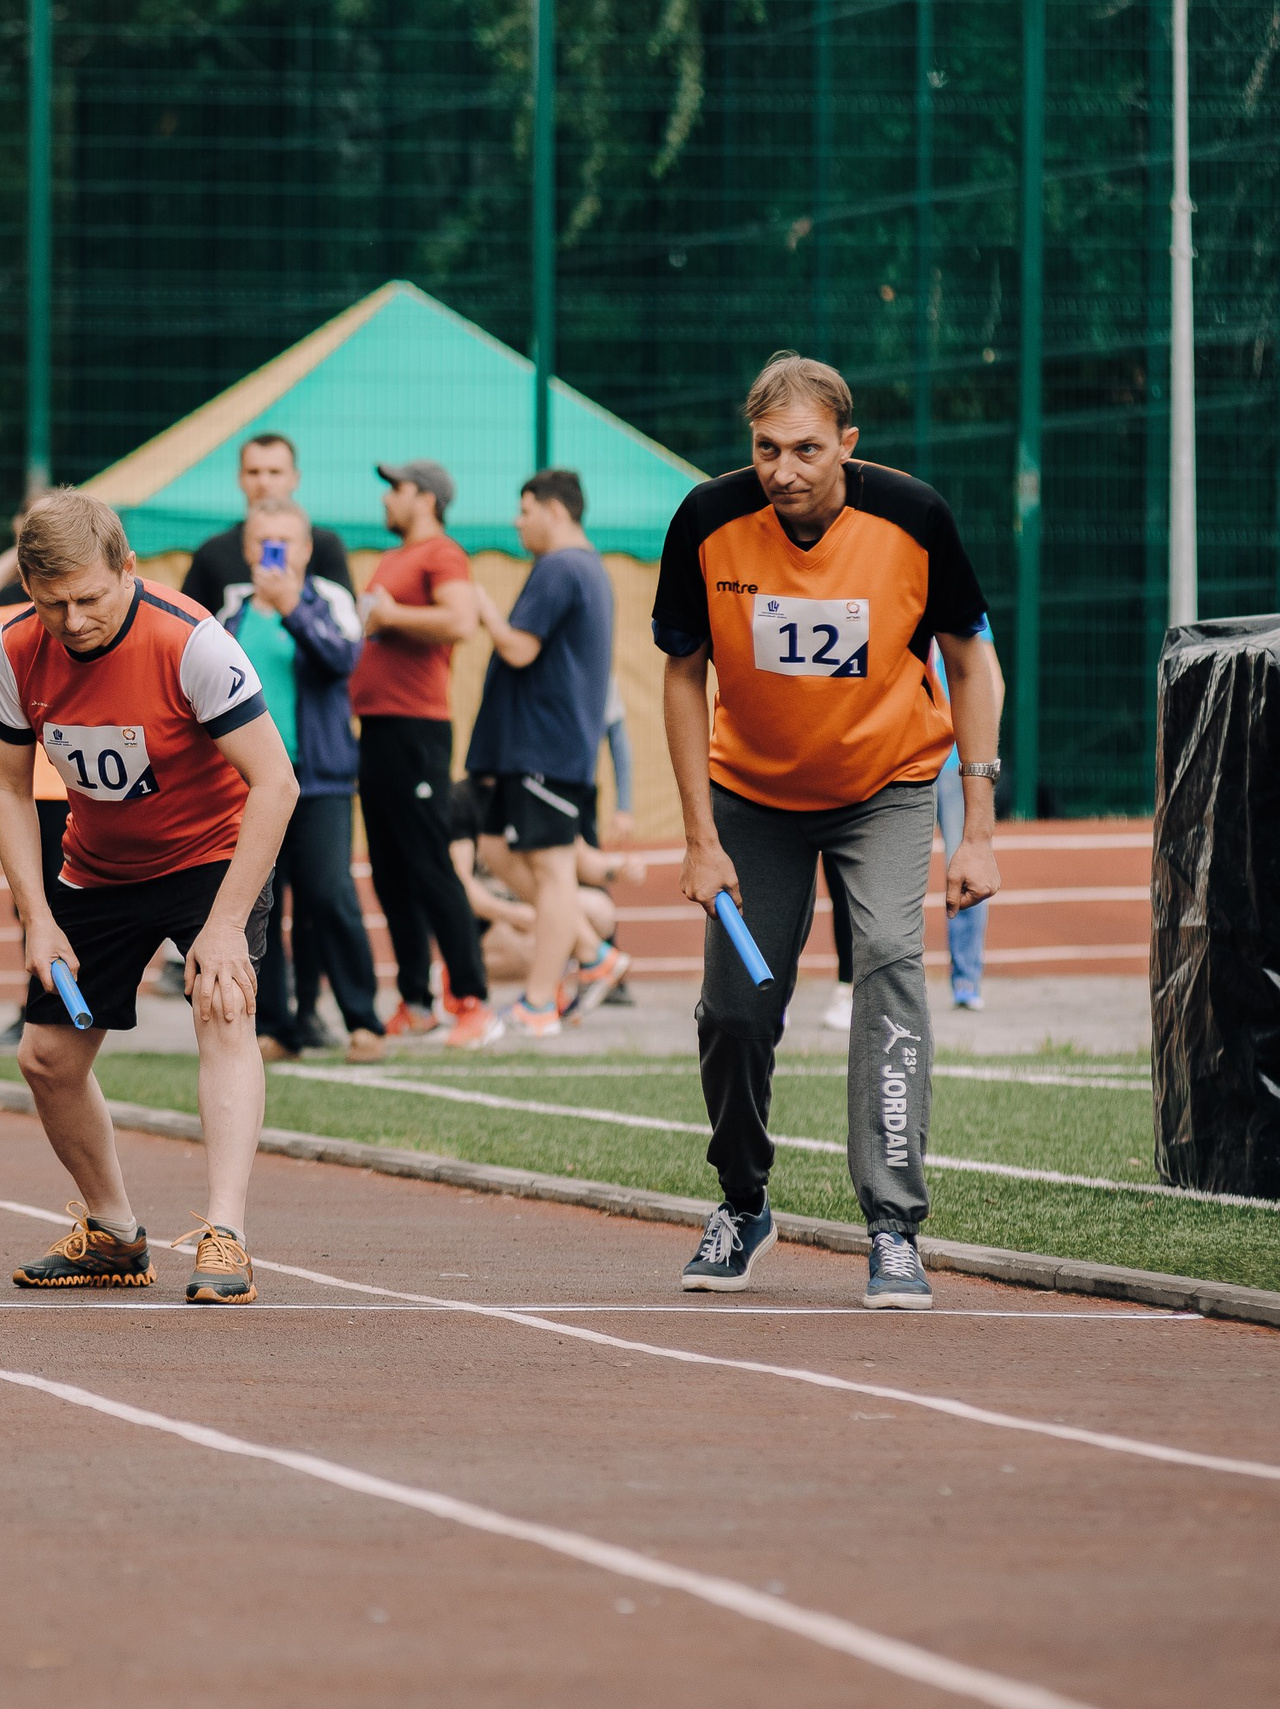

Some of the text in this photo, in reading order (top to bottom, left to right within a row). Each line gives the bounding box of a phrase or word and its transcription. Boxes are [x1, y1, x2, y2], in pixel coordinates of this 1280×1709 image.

[717, 580, 759, 595] mitre
[779, 622, 842, 666] 12
[848, 658, 862, 674] 1
[67, 748, 129, 791] 10
[138, 780, 152, 794] 1
[883, 1065, 909, 1168] JORDAN
